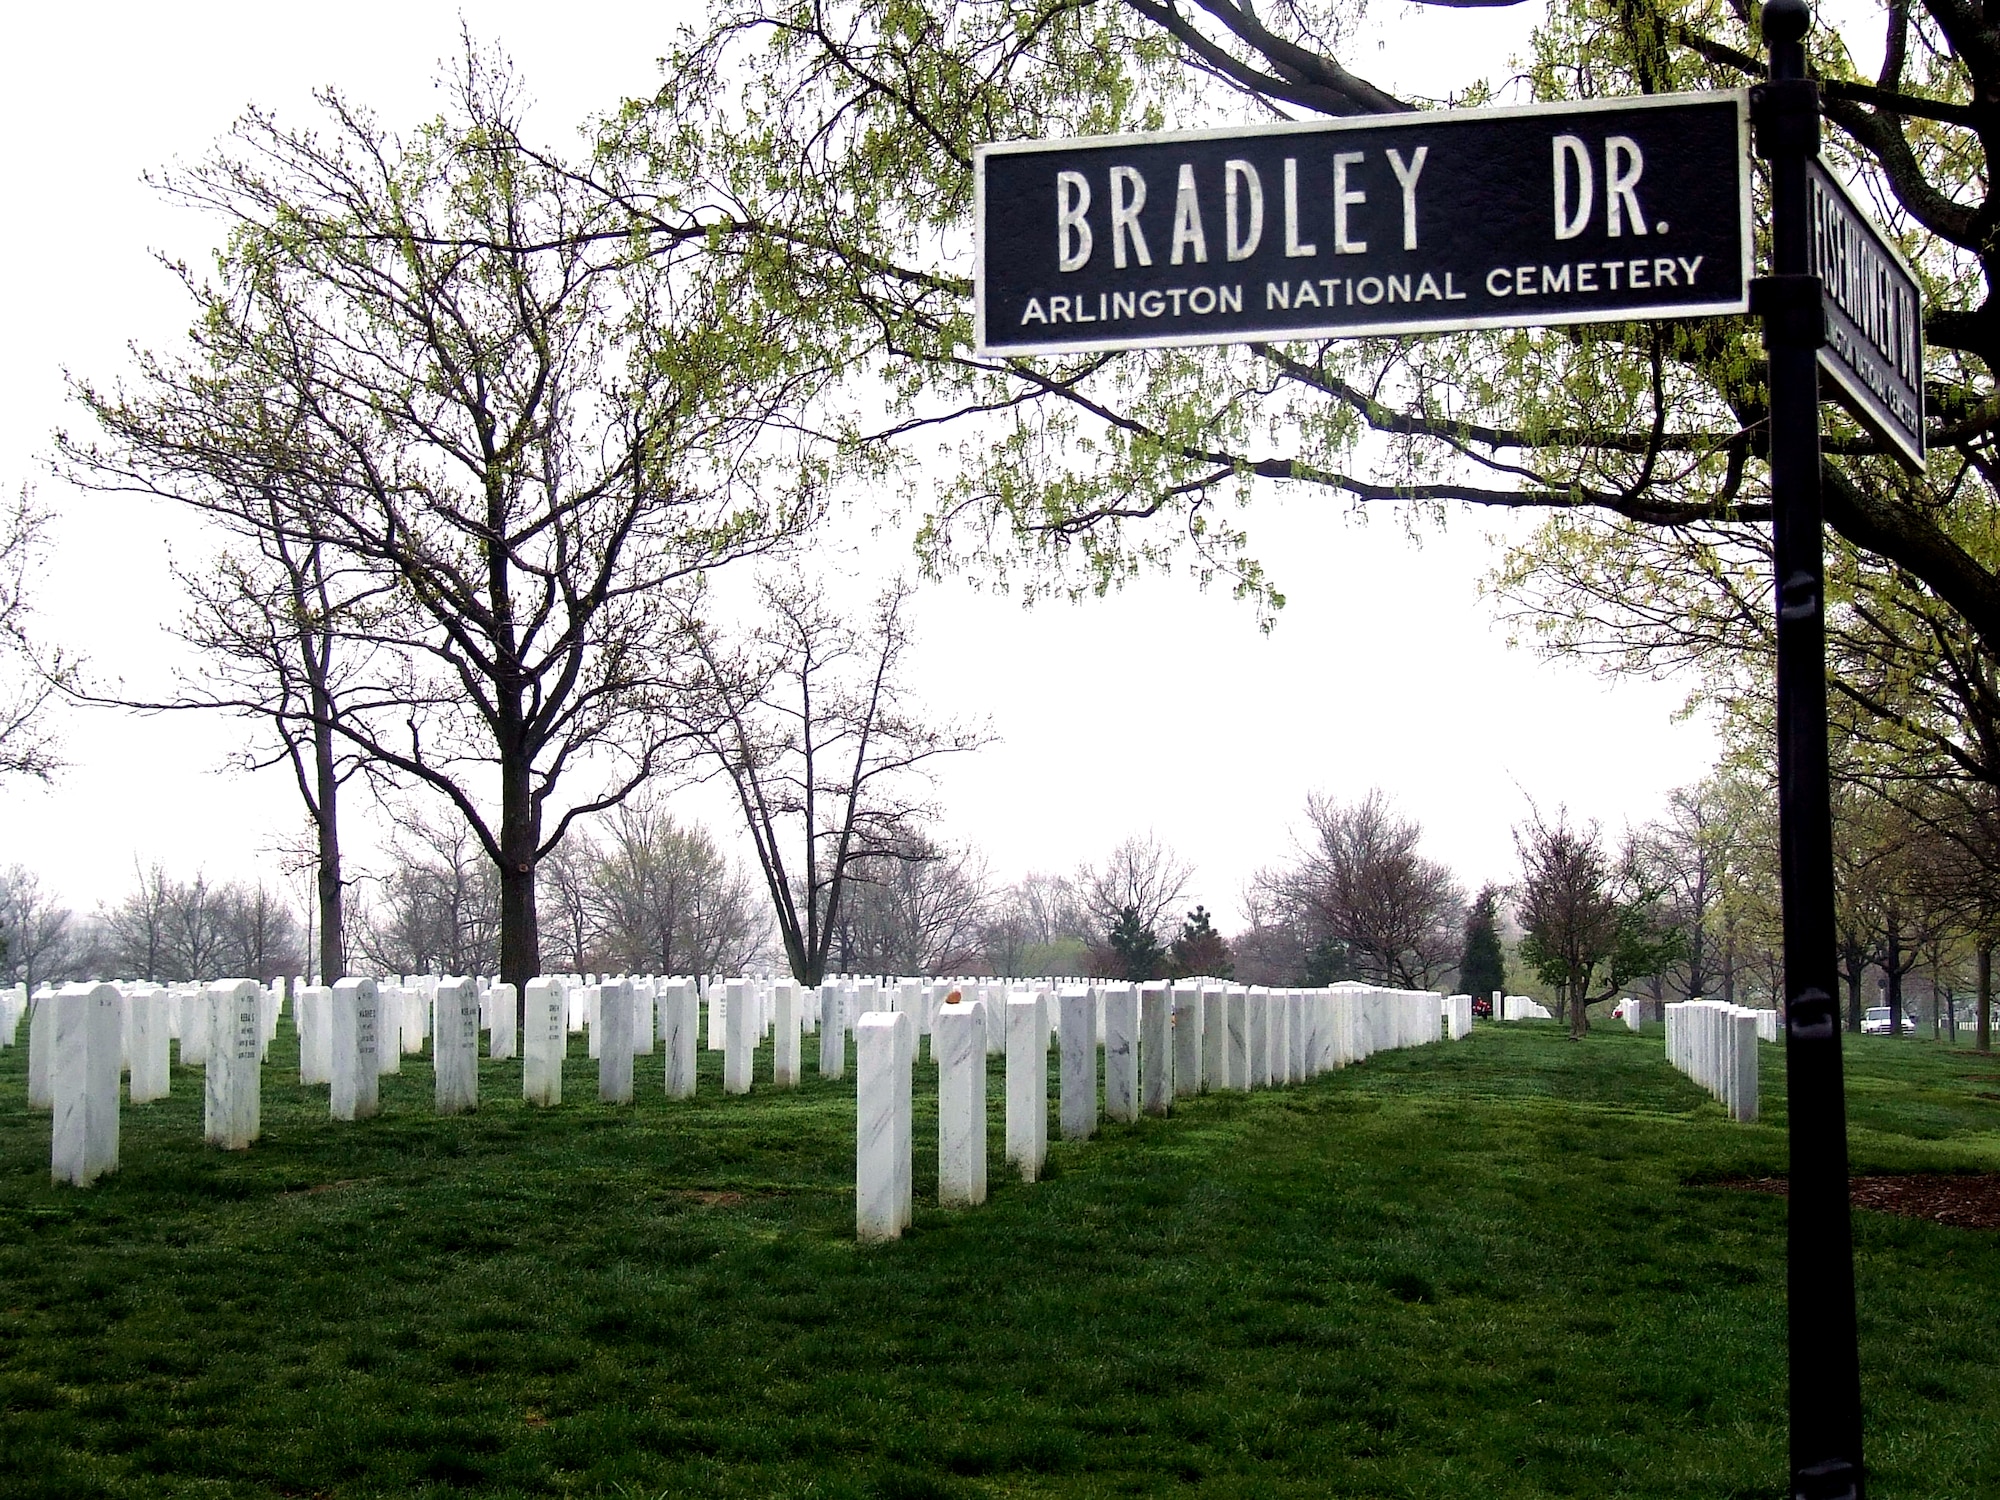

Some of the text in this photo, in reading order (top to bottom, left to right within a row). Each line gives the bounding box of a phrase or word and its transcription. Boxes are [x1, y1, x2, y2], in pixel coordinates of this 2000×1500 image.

[1057, 134, 1670, 272] BRADLEY DR.
[1021, 255, 1703, 326] ARLINGTON NATIONAL CEMETERY
[1813, 178, 1895, 367] EISENHOWER
